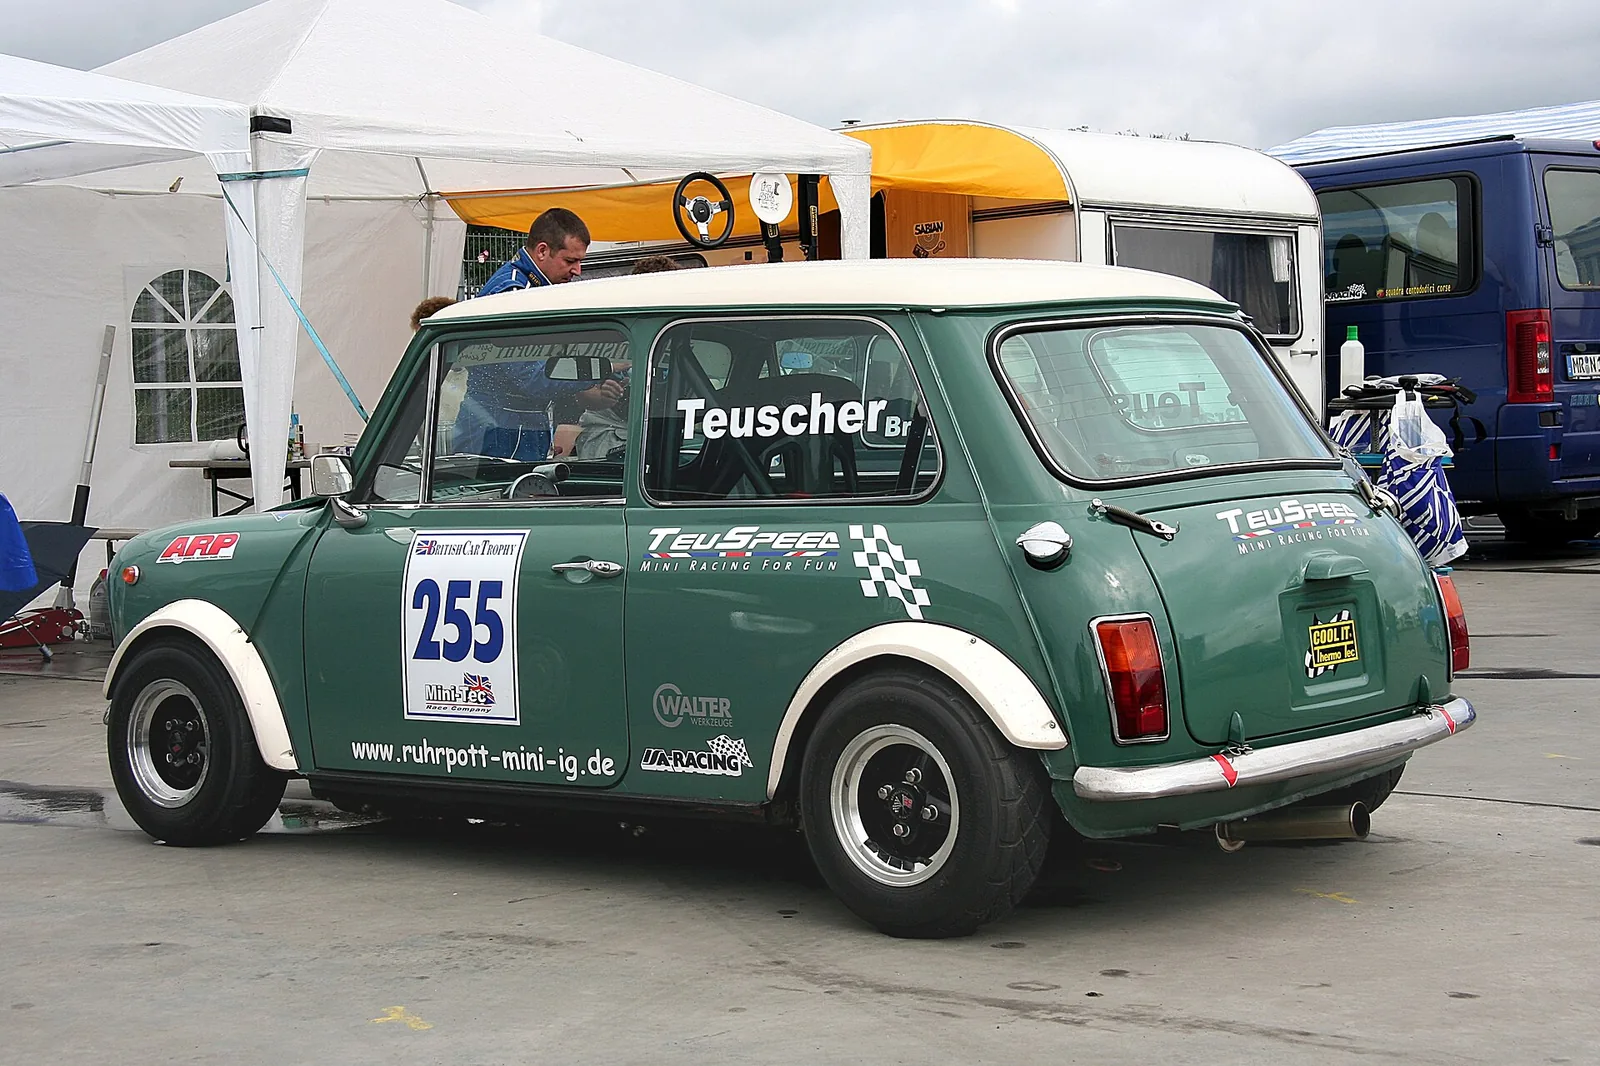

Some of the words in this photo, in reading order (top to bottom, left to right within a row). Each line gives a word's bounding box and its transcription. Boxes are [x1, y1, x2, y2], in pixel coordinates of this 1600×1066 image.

[914, 221, 944, 236] SABIAN
[1385, 286, 1404, 297] squadra
[1436, 284, 1451, 293] corse
[677, 392, 887, 440] Teuscher
[884, 416, 912, 437] Br
[161, 534, 239, 558] ARP
[427, 540, 461, 555] BRITISH
[462, 540, 480, 555] CAR
[480, 540, 516, 555] TROPHY
[1237, 539, 1272, 555] MINI
[1277, 530, 1323, 546] RACING
[1327, 526, 1347, 538] FOR
[1350, 526, 1370, 537] FUN
[640, 560, 679, 572] MINI
[689, 560, 750, 571] RACING
[762, 560, 792, 571] FOR
[804, 560, 837, 571] FUN
[413, 578, 504, 663] 255
[1313, 627, 1339, 645] COOL
[1316, 644, 1342, 663] Thermo
[1344, 642, 1356, 658] Tec
[425, 684, 487, 704] Mini-Tec
[451, 706, 492, 714] Company
[659, 695, 733, 718] WALTER
[691, 717, 733, 728] WERKZEUGE
[351, 738, 616, 781] www.ruhrpott-mini-ig.de
